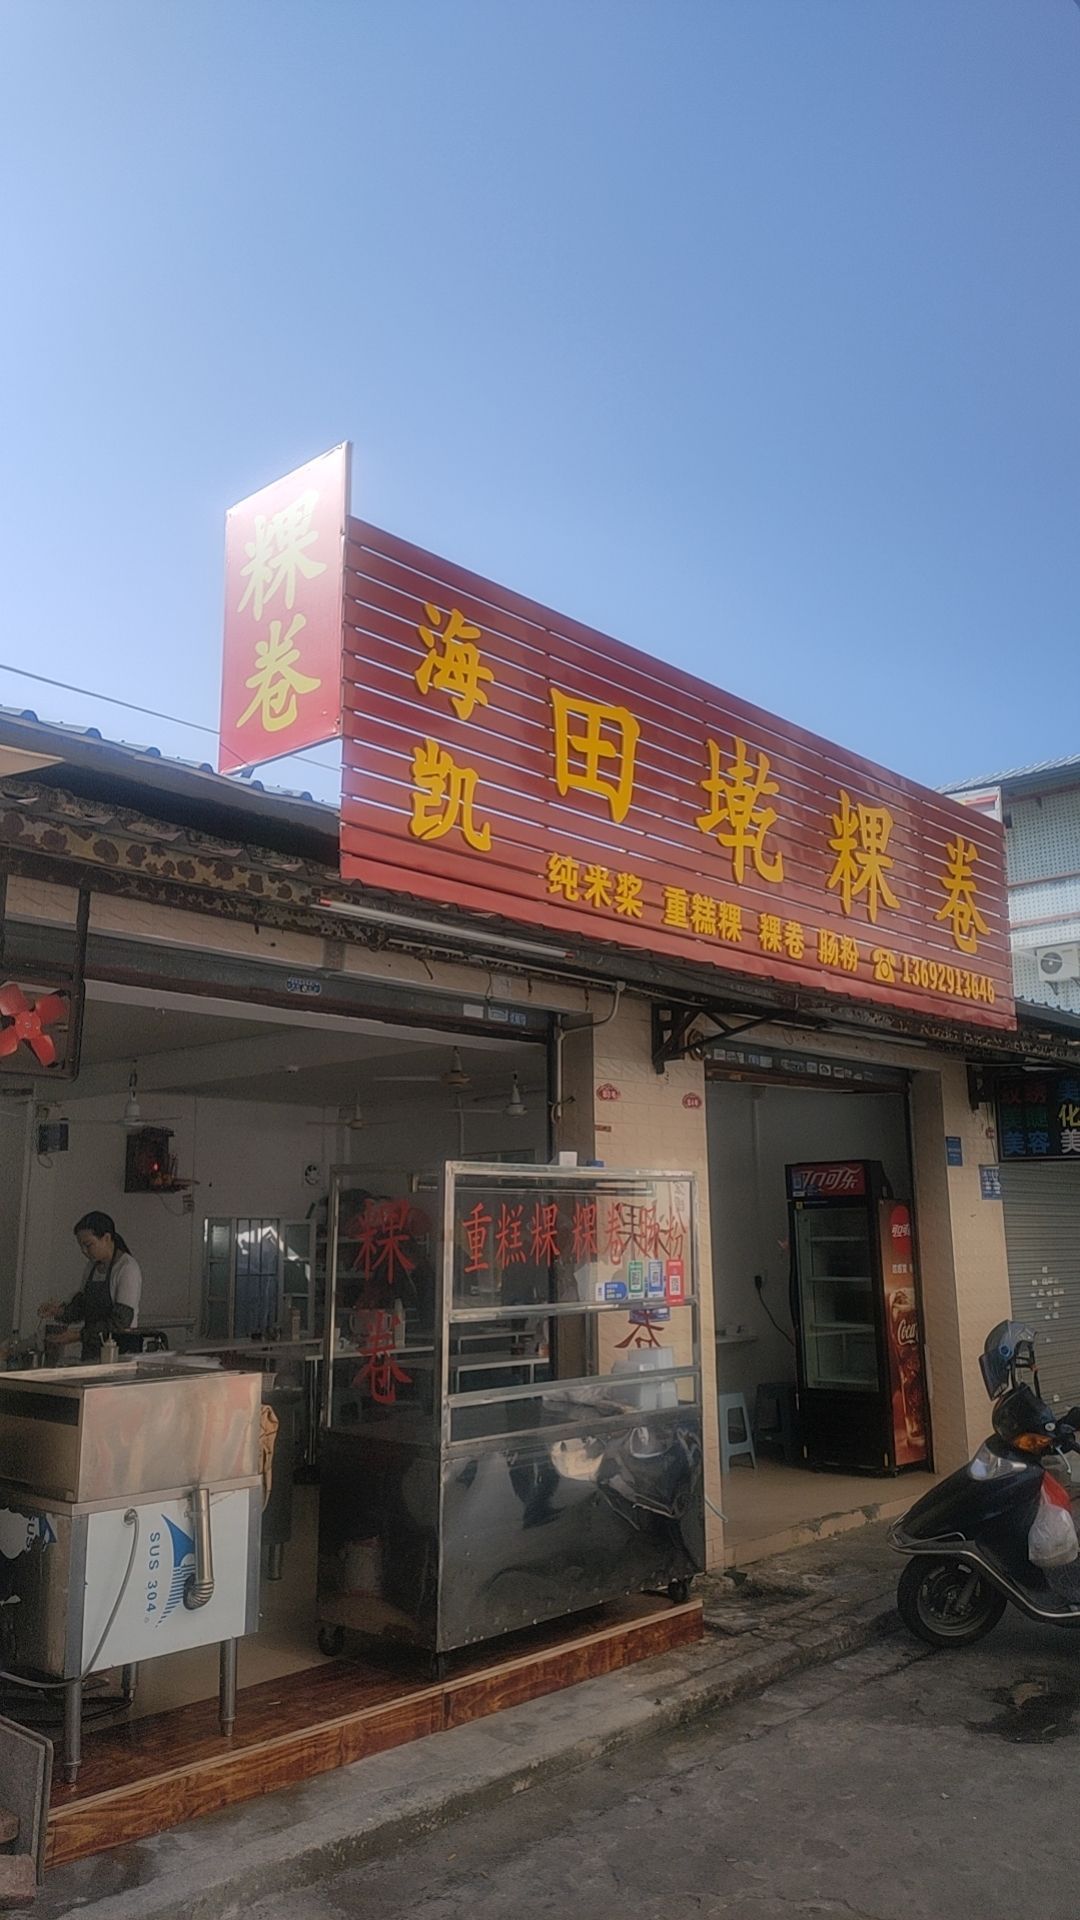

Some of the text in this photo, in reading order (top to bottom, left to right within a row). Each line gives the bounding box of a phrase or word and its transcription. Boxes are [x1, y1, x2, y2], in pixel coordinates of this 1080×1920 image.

[236, 489, 328, 733] 粿卷
[409, 602, 495, 852] 海凯
[547, 852, 996, 1005] 纯米浆 重糕粿 粿卷 肠粉 13692913646
[146, 1531, 161, 1613] SUS 304
